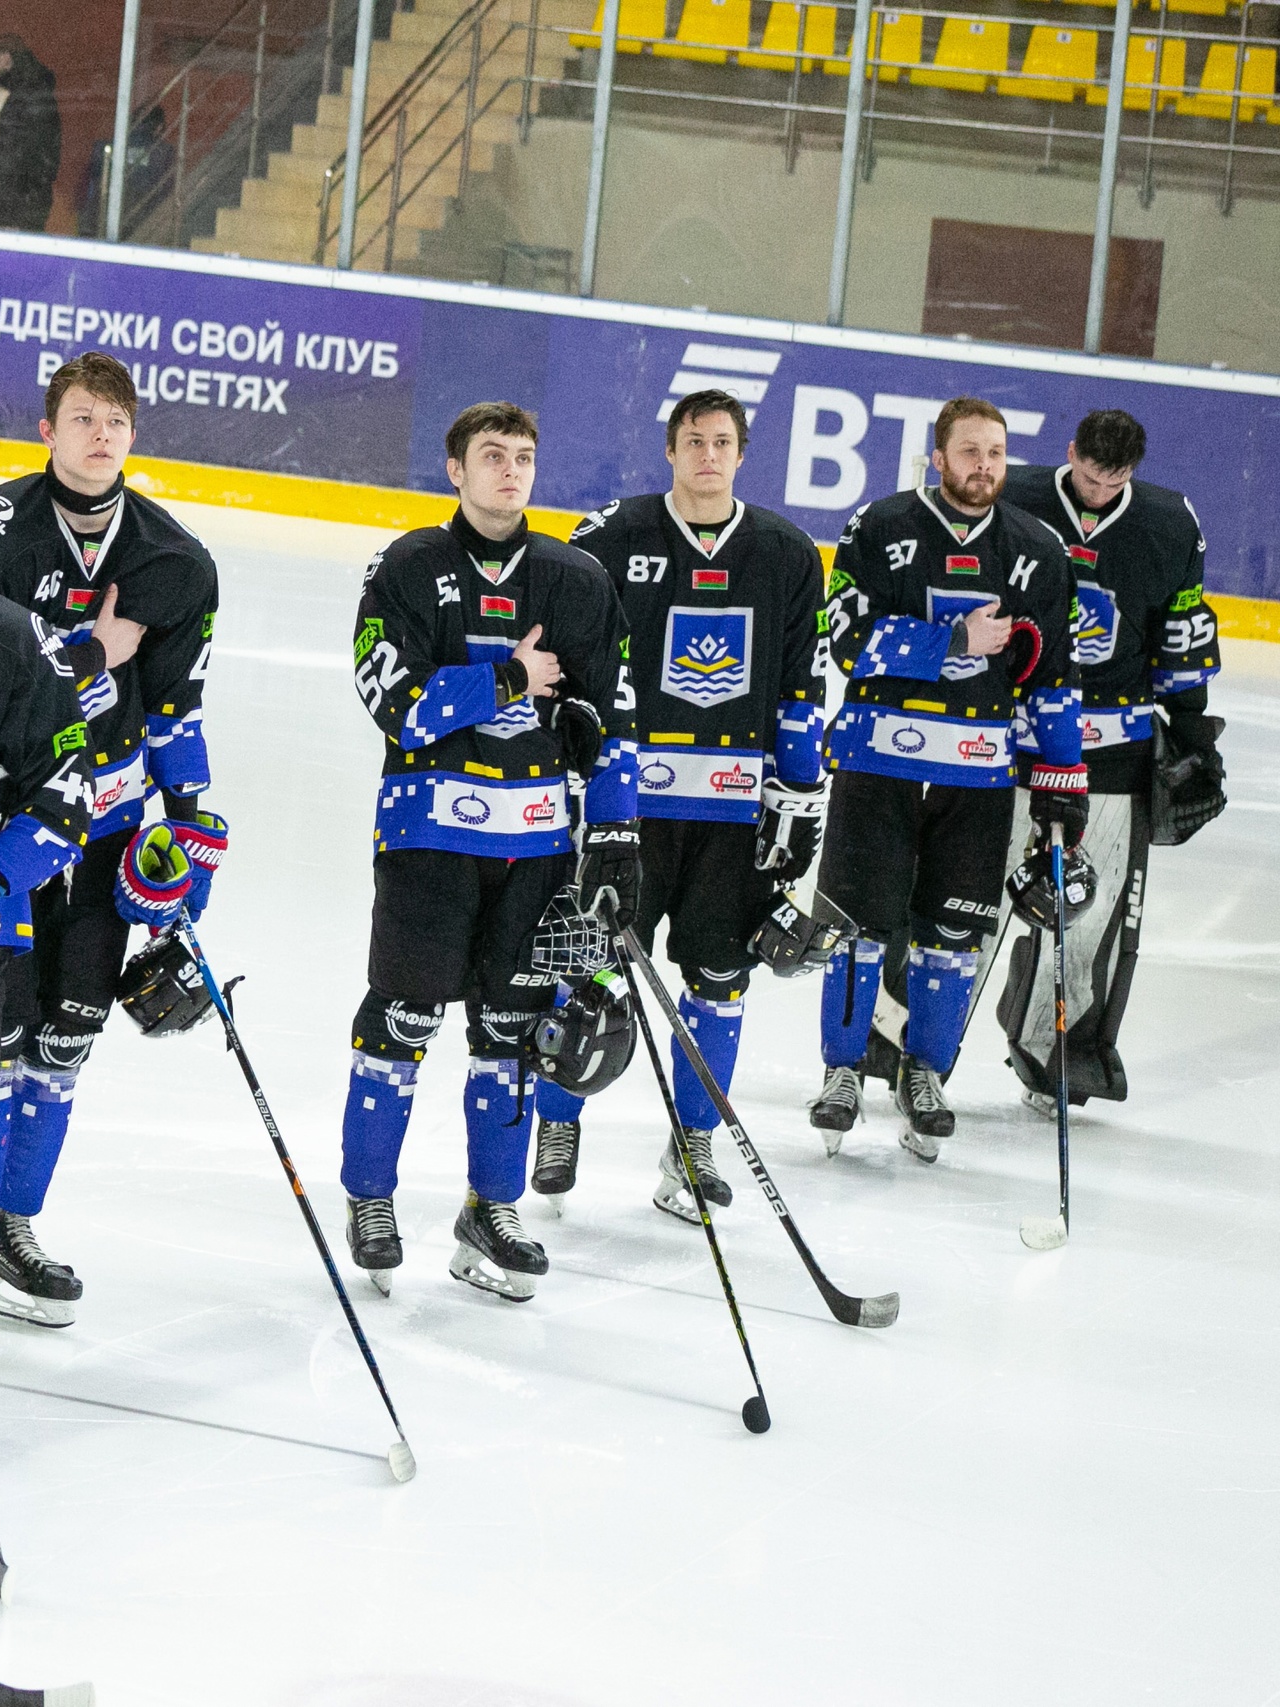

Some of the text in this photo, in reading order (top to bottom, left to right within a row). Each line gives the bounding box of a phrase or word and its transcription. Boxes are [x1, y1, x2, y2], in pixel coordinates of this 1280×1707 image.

[171, 318, 285, 366] СВОЙ
[294, 332, 399, 379] КЛУБ
[36, 351, 289, 415] В ЦСЕТЯХ
[626, 555, 668, 583] 87
[885, 539, 918, 571] 37
[34, 569, 64, 602] 46
[826, 586, 869, 643] 37
[1161, 612, 1215, 653] 35
[355, 640, 411, 716] 52
[614, 665, 636, 710] 5
[724, 776, 752, 785] ТРАНС
[587, 831, 640, 845] EAST
[1011, 866, 1032, 891] 37
[771, 902, 798, 929] 87
[943, 897, 1000, 919] BAUE
[177, 960, 204, 989] 46
[510, 973, 559, 987] BAU
[60, 998, 108, 1020] CCM
[256, 1097, 279, 1139] BAUER
